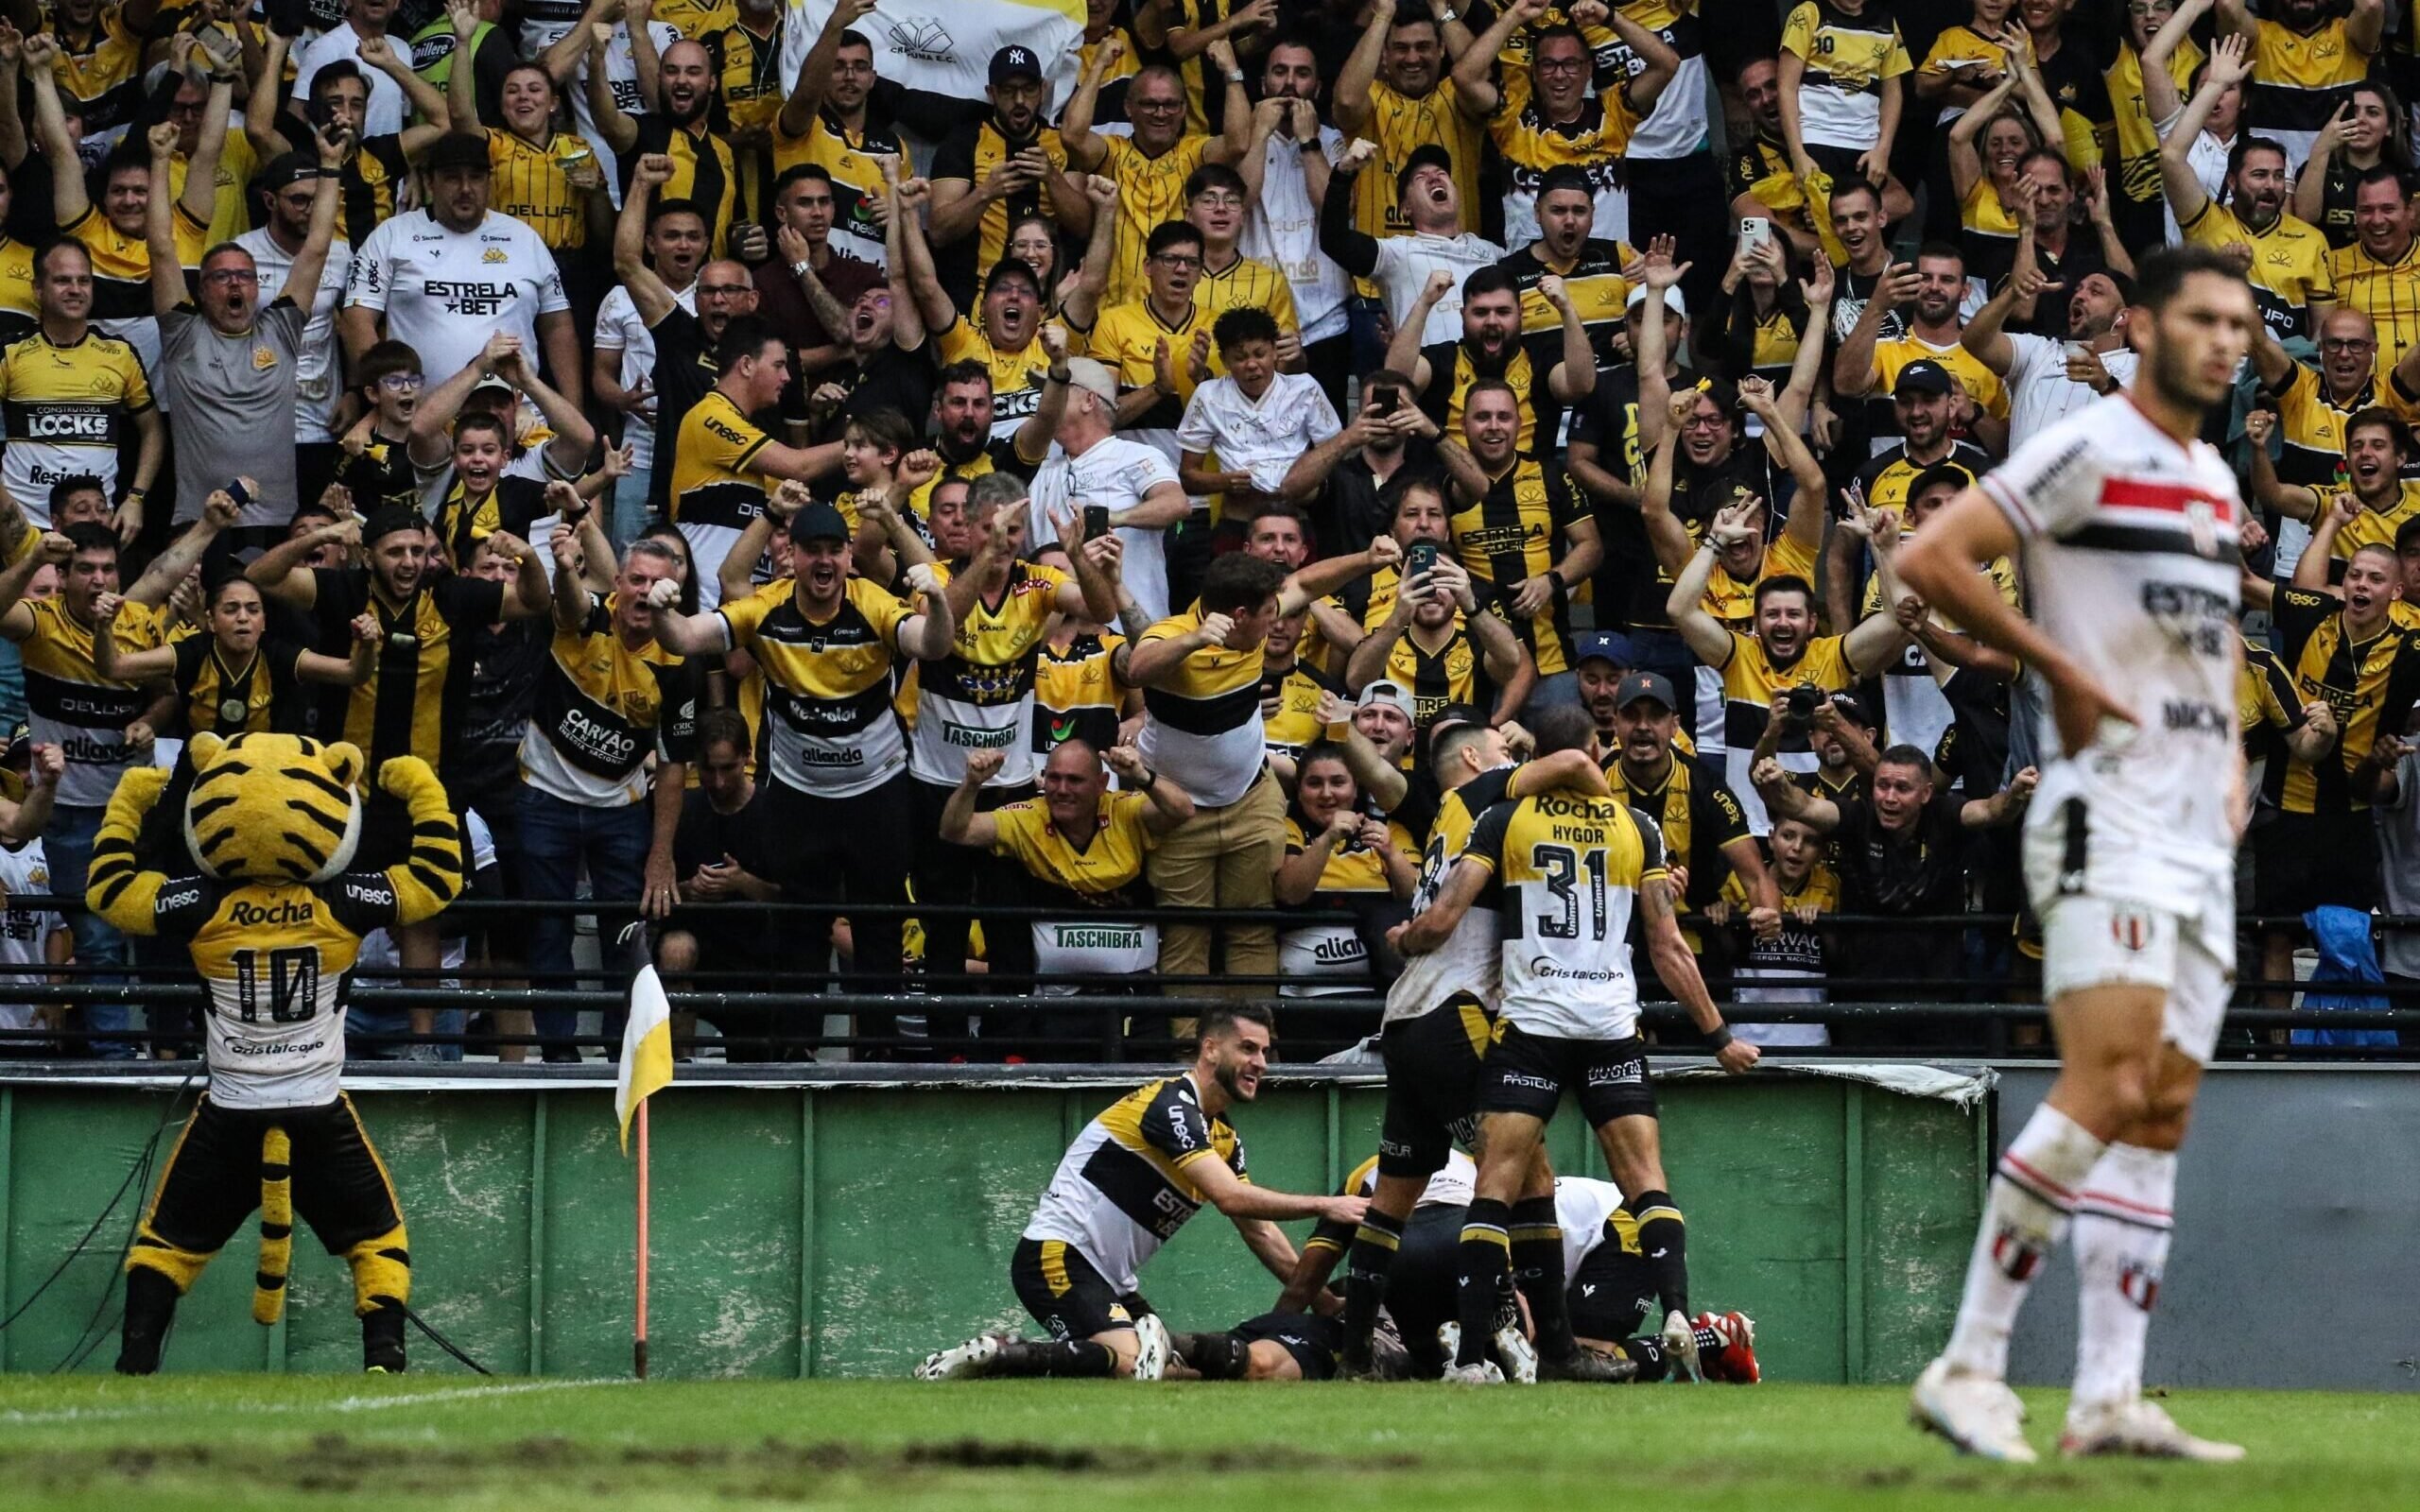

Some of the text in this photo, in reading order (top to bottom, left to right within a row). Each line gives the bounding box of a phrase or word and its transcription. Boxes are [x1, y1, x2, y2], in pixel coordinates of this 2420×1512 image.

[412, 42, 449, 63] pillere
[1816, 36, 1835, 54] 10
[424, 280, 519, 298] ESTRELA
[461, 299, 501, 315] BET
[37, 405, 101, 415] CONSTRUTORA
[28, 414, 109, 438] LOCKS
[704, 416, 748, 446] unesc
[1460, 523, 1544, 544] ESTRELA
[2285, 592, 2321, 606] nesc
[2299, 673, 2376, 709] ESTRELA
[567, 709, 635, 752] CARVÃO
[942, 719, 1018, 748] TASCHIBRA
[803, 747, 863, 766] alianda
[1534, 795, 1616, 819] Rocha
[1553, 825, 1605, 844] HYGOR
[155, 888, 199, 914] unesc
[346, 884, 392, 905] unesc
[1532, 843, 1608, 941] 31
[1595, 875, 1603, 918] Unimed
[229, 900, 314, 925] Rocha
[1567, 893, 1576, 936] Unimed
[1054, 924, 1144, 949] TASCHIBRA
[230, 946, 320, 1022] 10
[1540, 966, 1624, 982] Cristalcopo
[1503, 1074, 1558, 1093] PASTEUR
